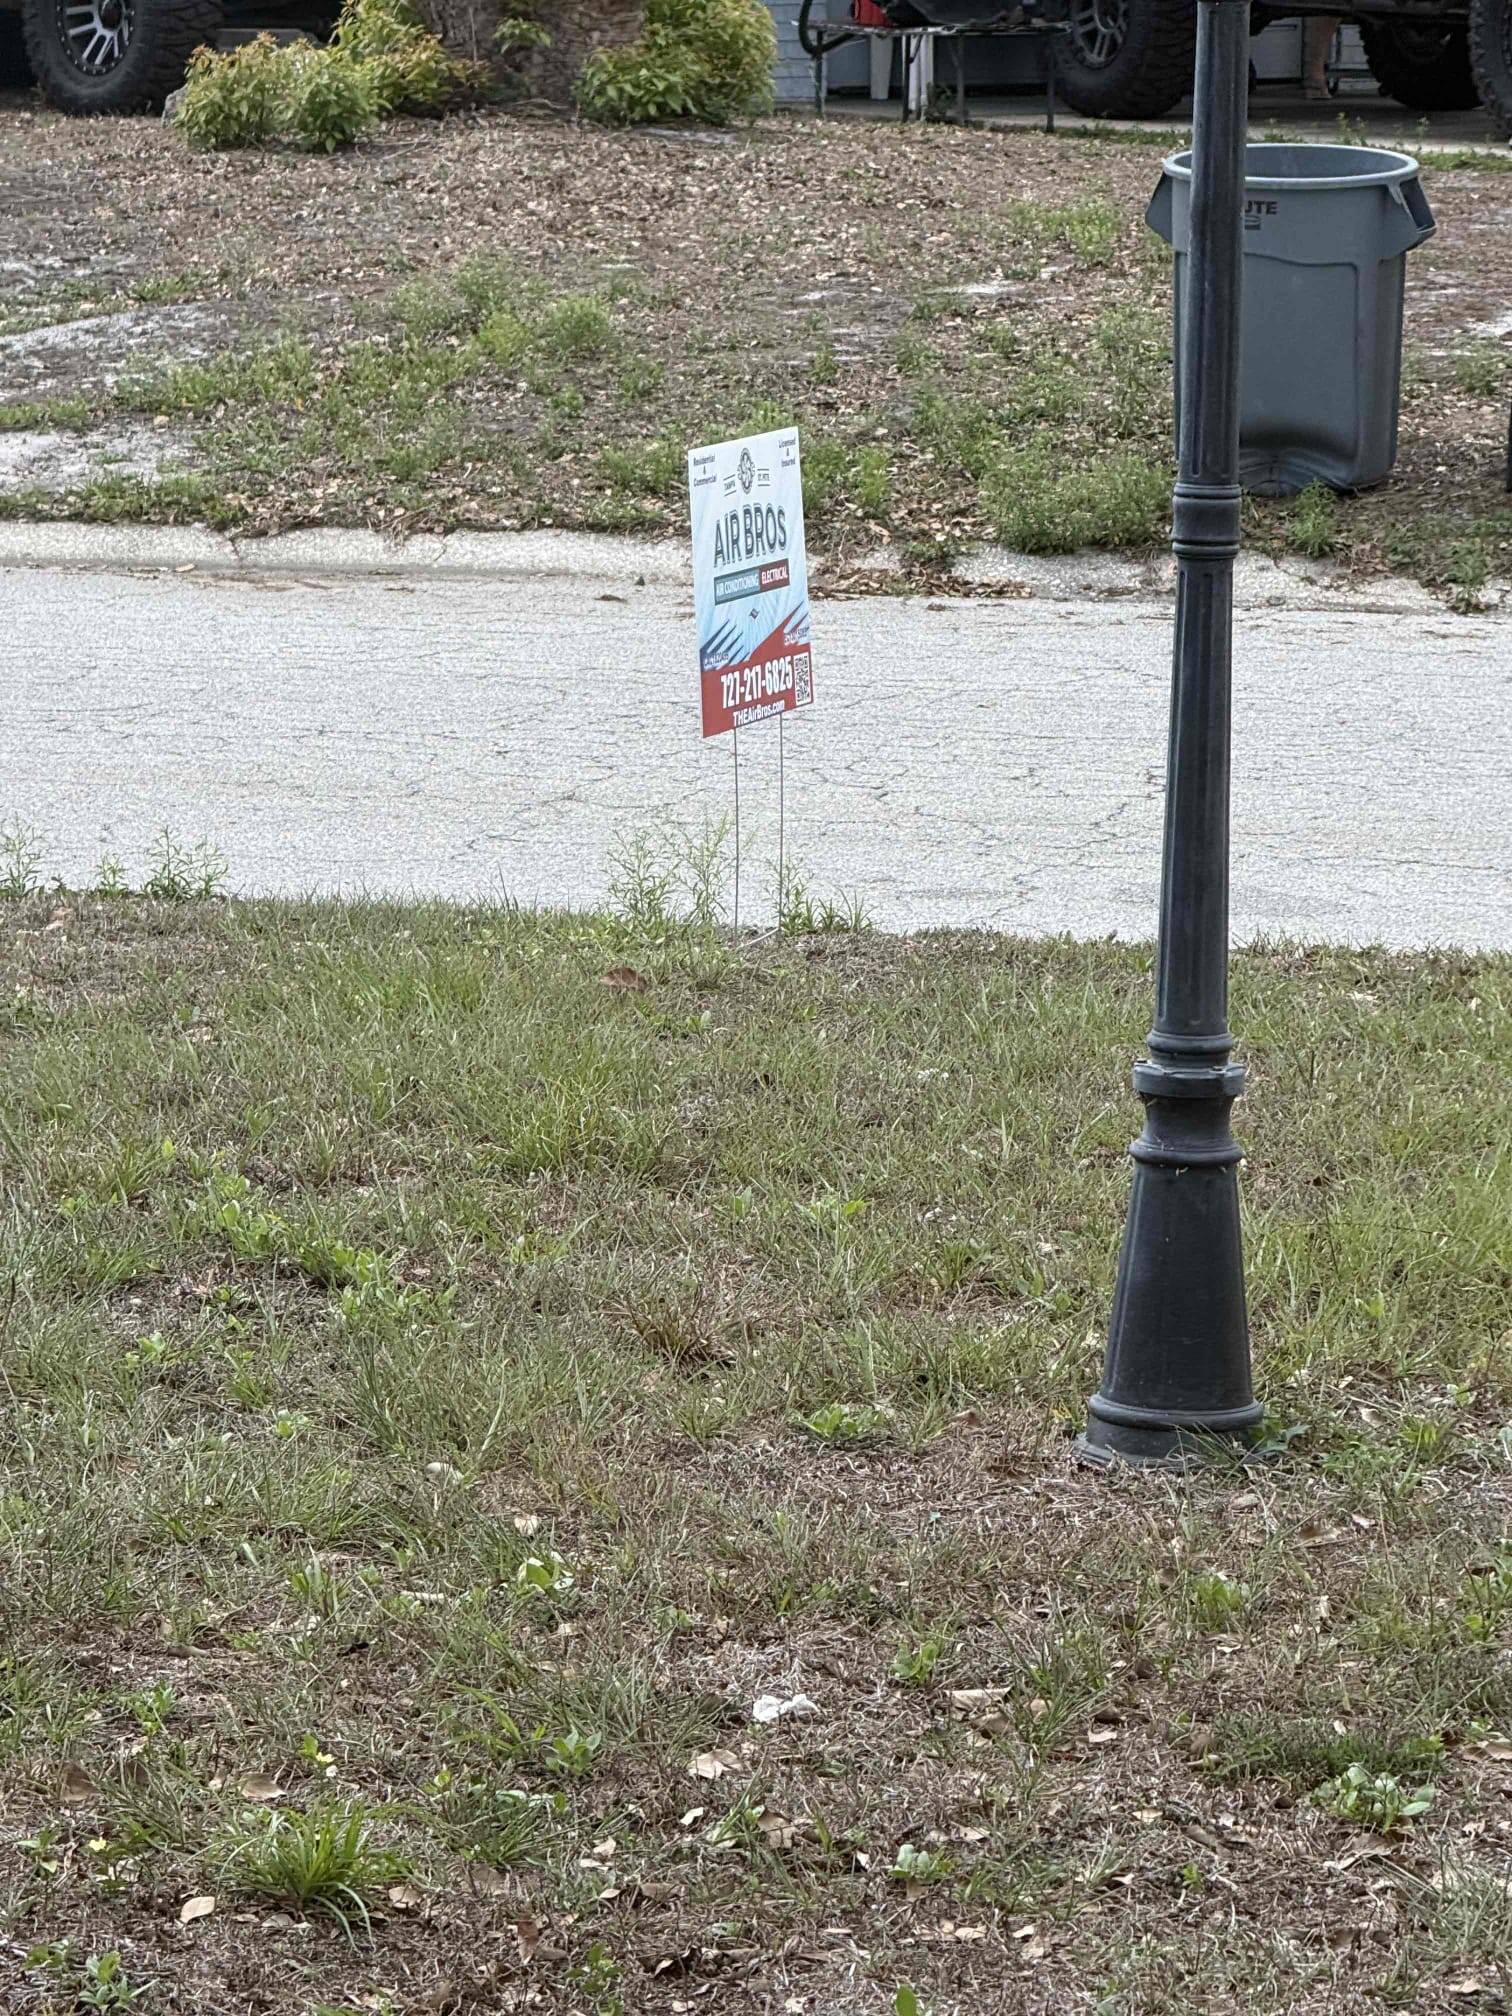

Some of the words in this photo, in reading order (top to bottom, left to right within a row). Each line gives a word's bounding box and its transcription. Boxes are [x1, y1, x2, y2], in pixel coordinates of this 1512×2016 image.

[1245, 200, 1278, 215] UTE
[713, 509, 742, 568] AIR
[743, 502, 787, 559] BROS
[761, 566, 788, 585] ELECTRICAL
[720, 655, 793, 709] 727-217-6825
[732, 699, 785, 727] THEAirBros.com
